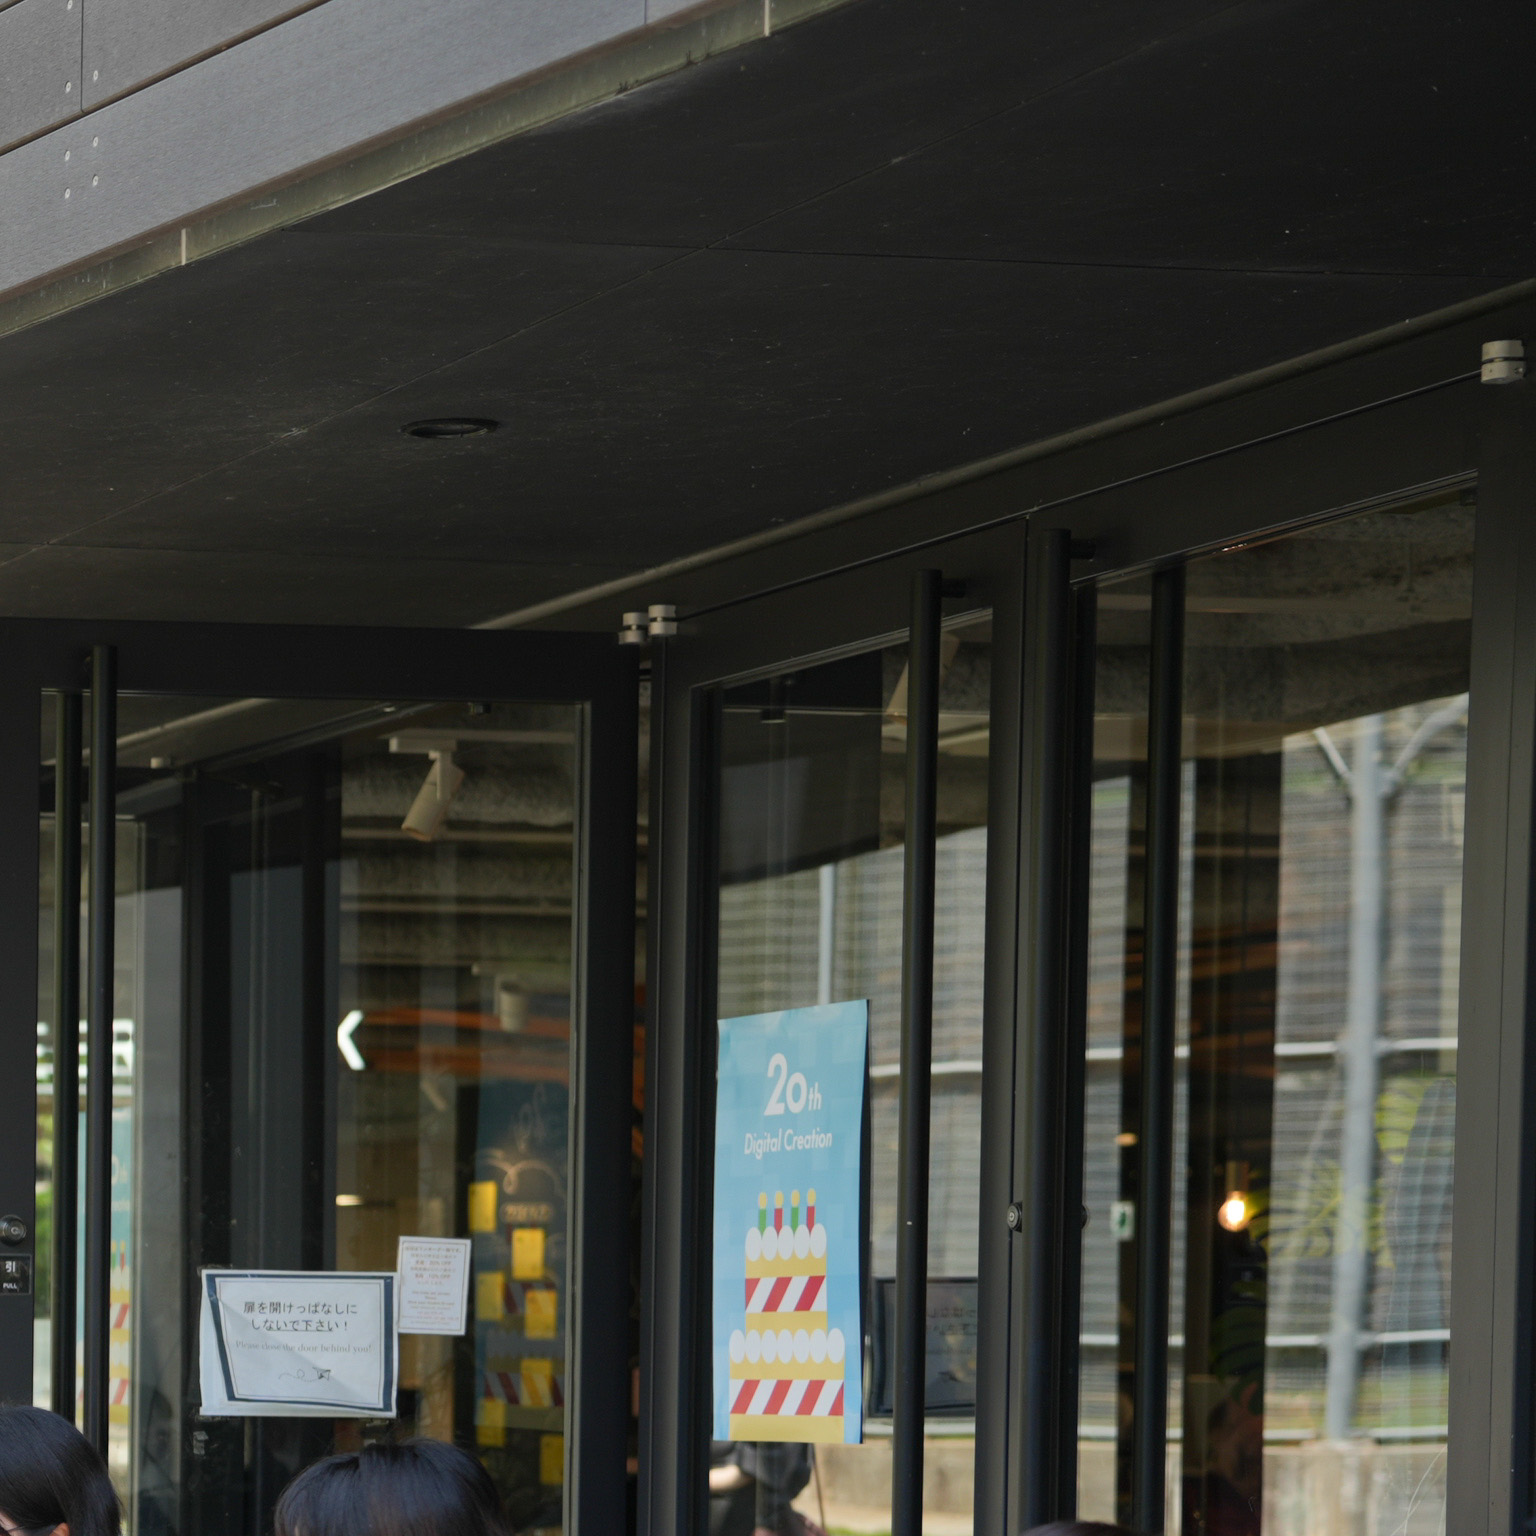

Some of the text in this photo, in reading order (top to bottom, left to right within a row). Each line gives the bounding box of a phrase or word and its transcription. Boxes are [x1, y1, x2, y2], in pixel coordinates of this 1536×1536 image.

[764, 1052, 822, 1116] 20th
[744, 1127, 833, 1160] Digital Creation
[5, 1260, 16, 1273] 引
[243, 1301, 358, 1314] 扉を開けっぱなしに
[236, 1340, 373, 1354] Please close the door behind you!
